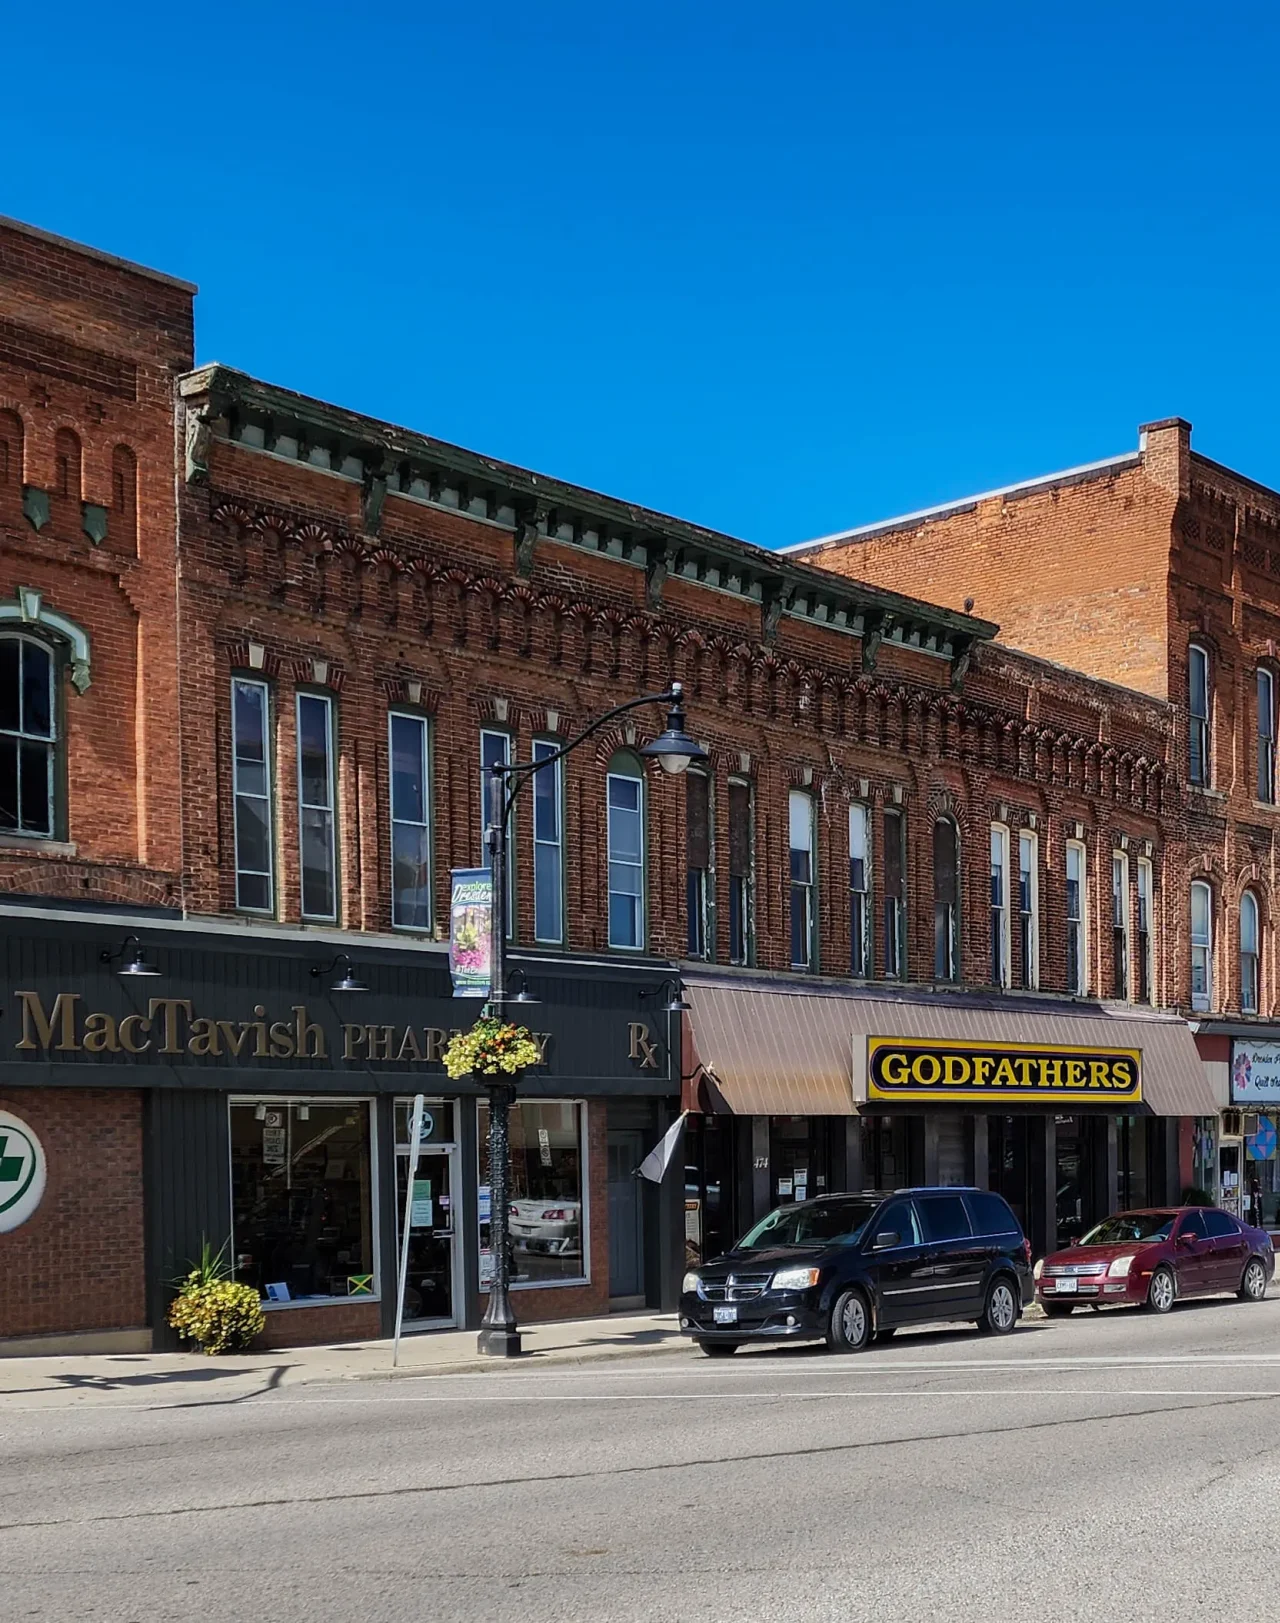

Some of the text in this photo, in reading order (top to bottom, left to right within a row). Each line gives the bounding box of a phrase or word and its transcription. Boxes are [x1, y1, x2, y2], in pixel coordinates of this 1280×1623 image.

[14, 990, 328, 1059] MacTavish
[340, 1023, 553, 1066] PHARY
[881, 1053, 1131, 1088] GODFATHERS
